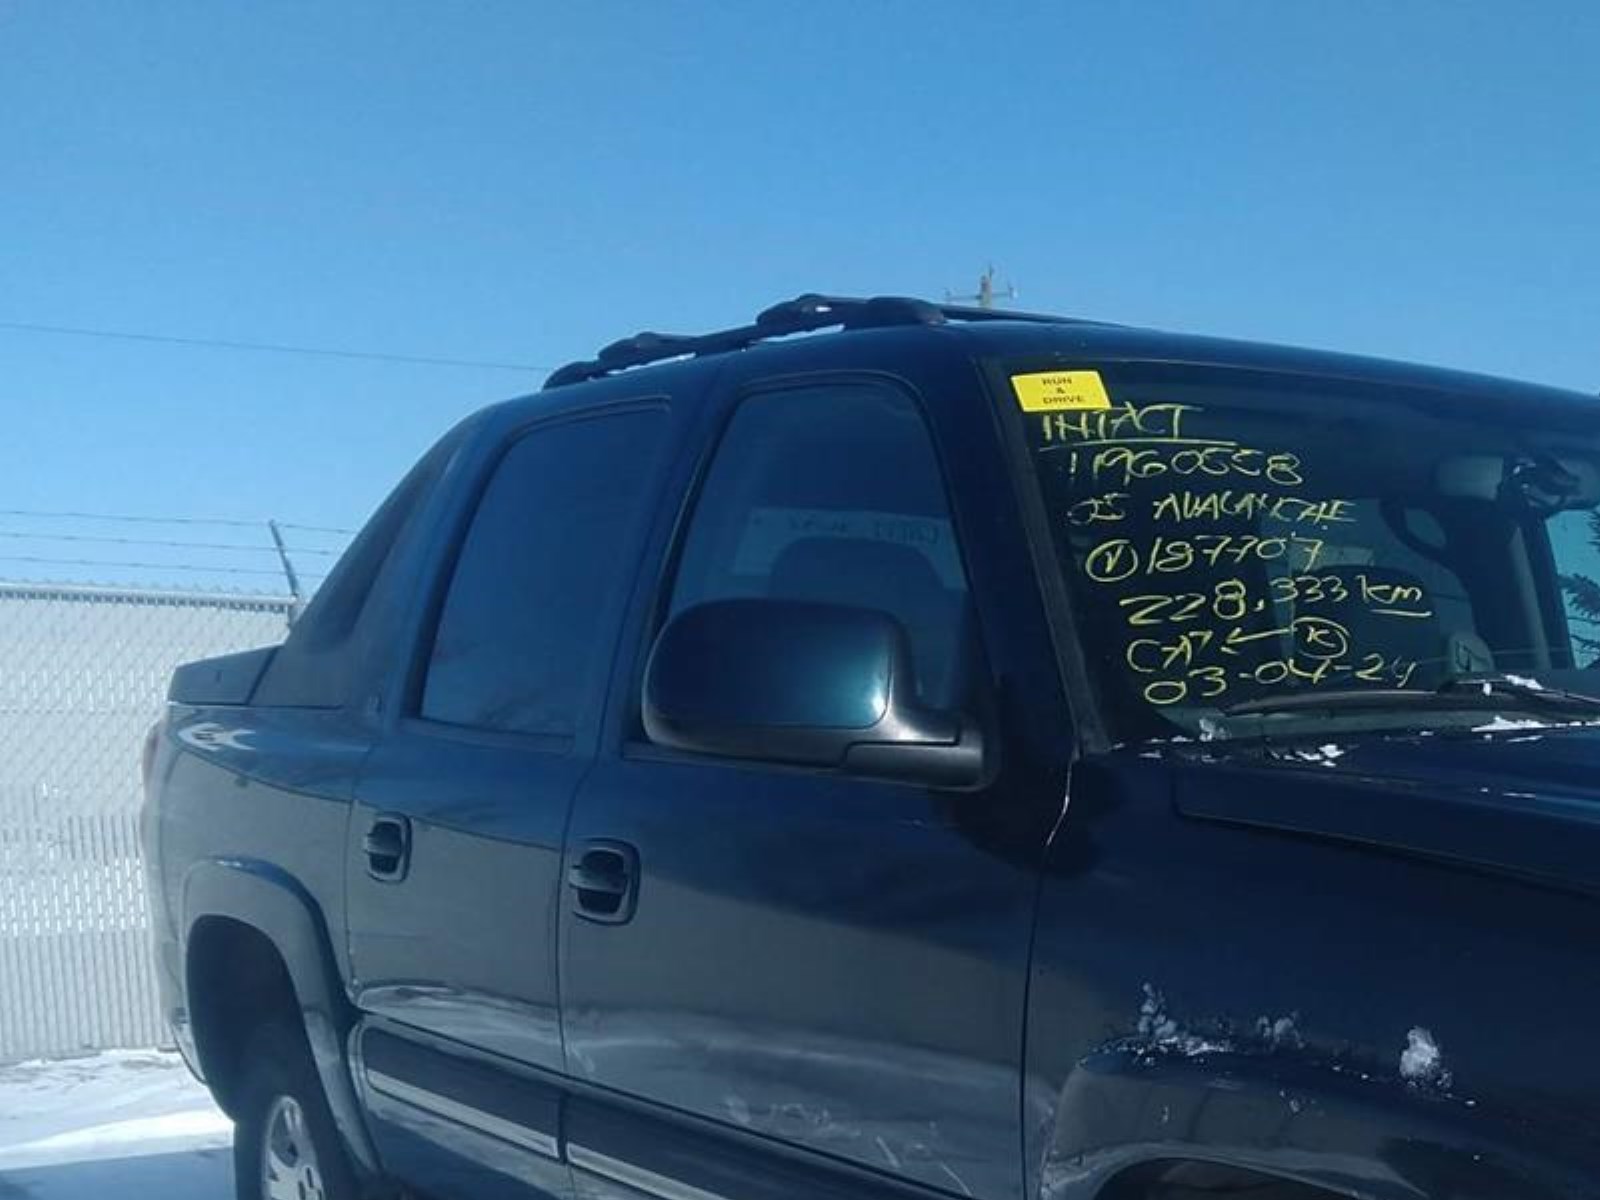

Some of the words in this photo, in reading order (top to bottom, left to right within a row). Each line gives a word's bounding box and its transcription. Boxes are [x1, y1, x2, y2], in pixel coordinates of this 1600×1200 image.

[1041, 377, 1072, 385] RUN
[1056, 386, 1065, 394] &
[1042, 395, 1085, 404] DRIVE
